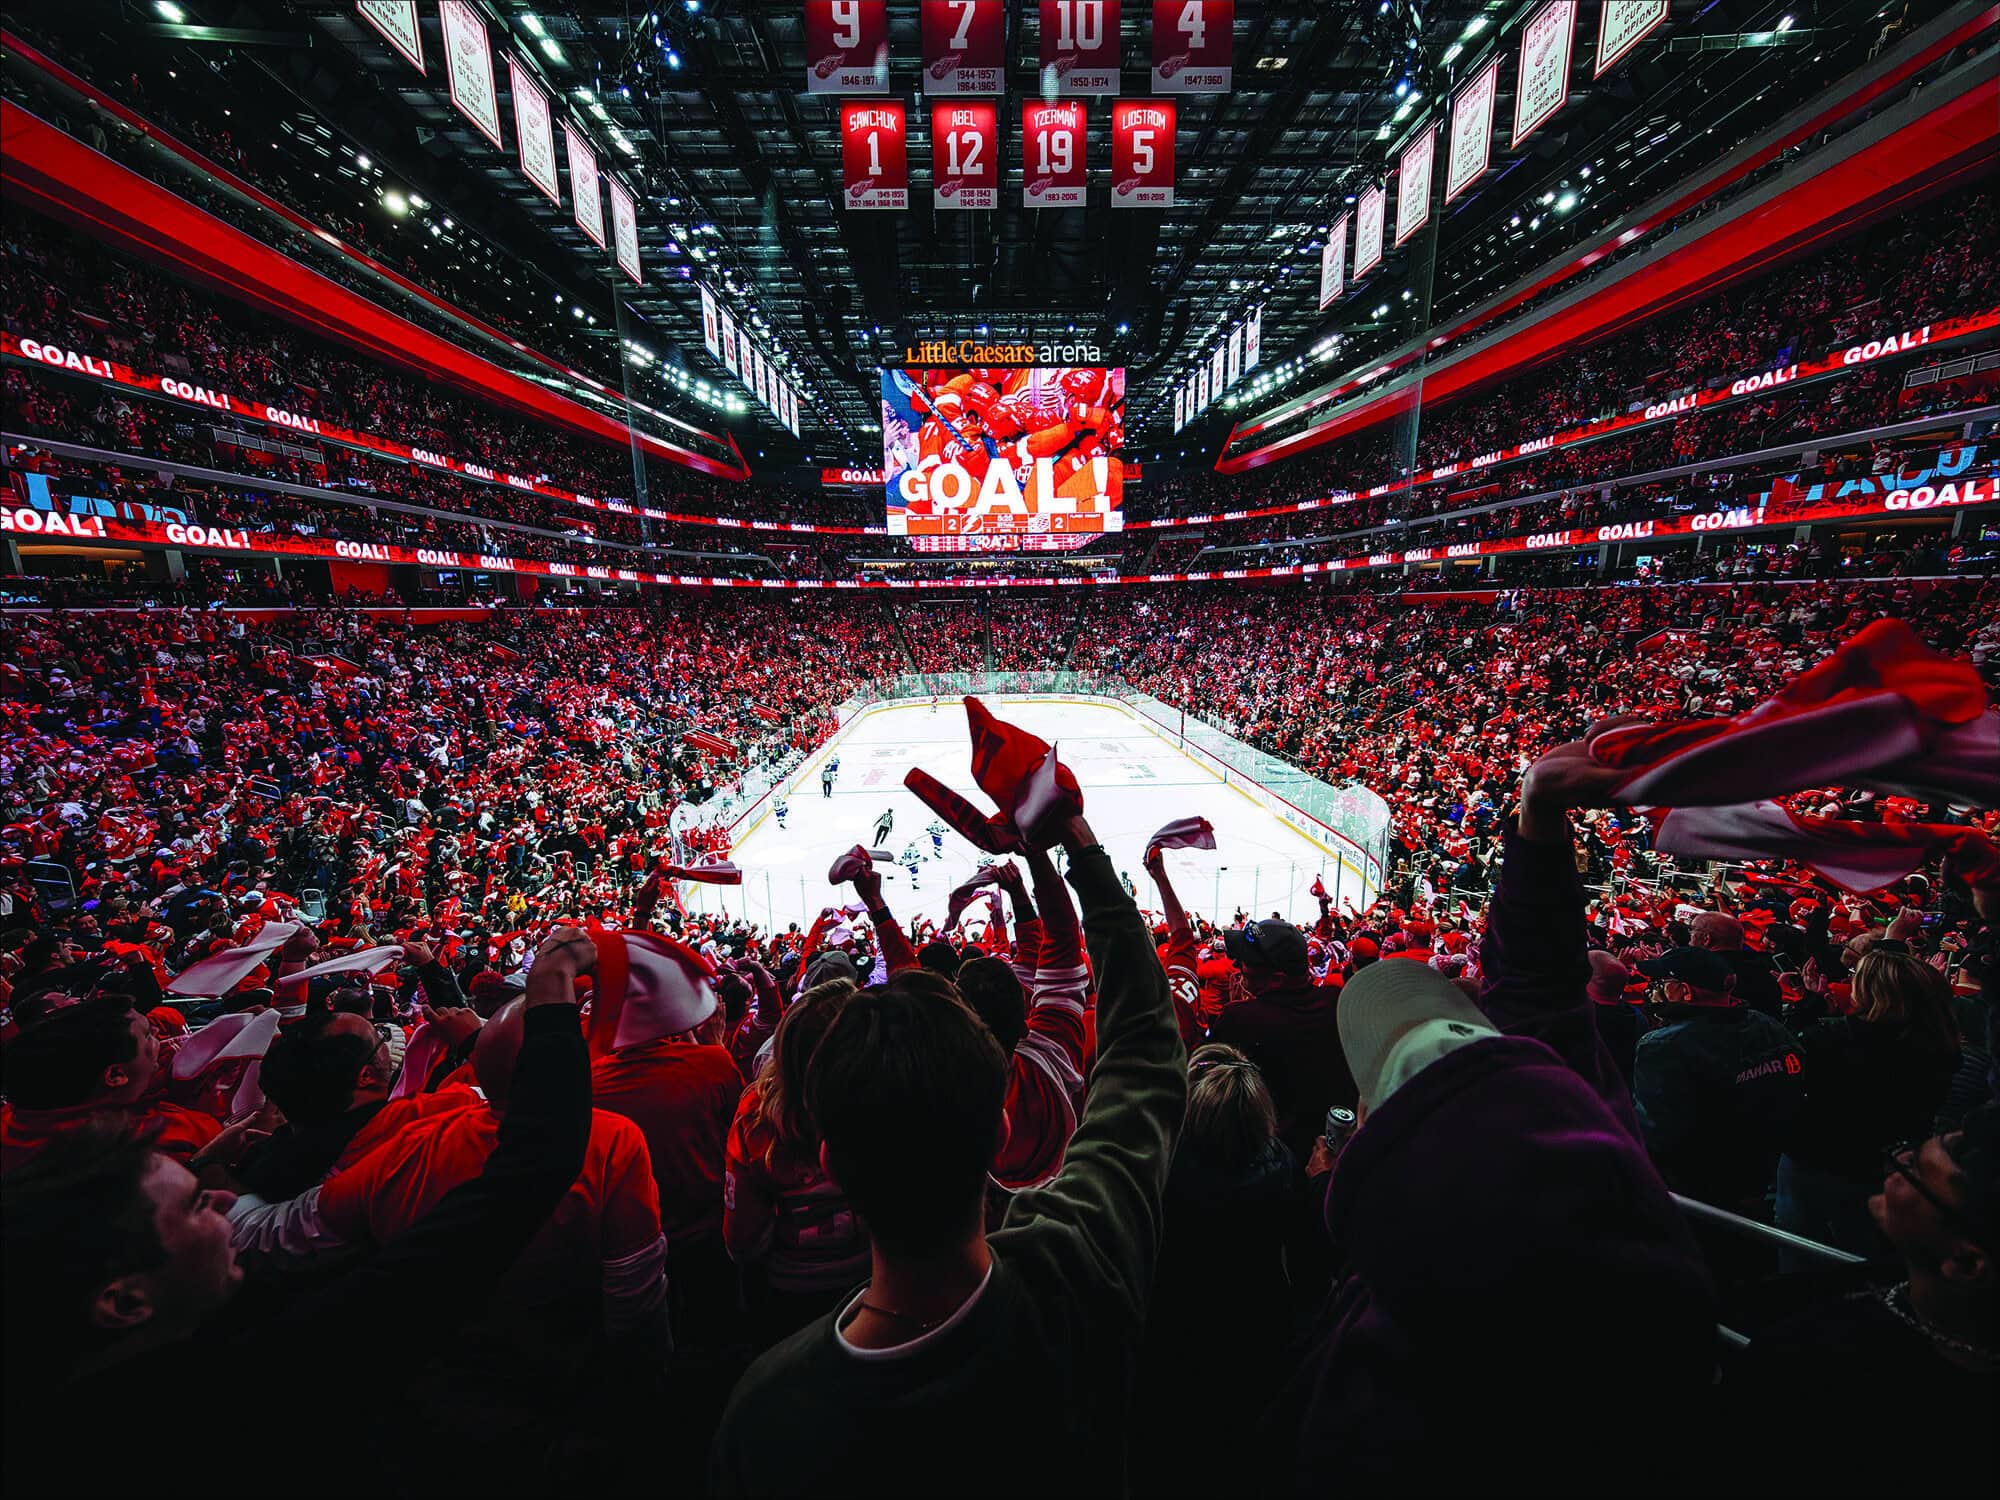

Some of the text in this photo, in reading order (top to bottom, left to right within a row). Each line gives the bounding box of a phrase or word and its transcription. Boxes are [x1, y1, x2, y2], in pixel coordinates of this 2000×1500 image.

[832, 0, 860, 48] 9
[949, 0, 976, 49] 7
[1057, 0, 1103, 50] 10
[1178, 0, 1206, 48] 4
[1605, 2, 1659, 54] CHAMPIONS
[952, 110, 977, 128] ABEL
[1033, 109, 1076, 129] YZERMAN
[1122, 109, 1166, 130] LIDSTROM
[1520, 88, 1559, 126] CHAMPIONS
[850, 110, 897, 132] SAWCHUK
[867, 131, 882, 175] 1
[946, 131, 984, 175] 12
[1036, 130, 1073, 174] 19
[1133, 130, 1154, 174] 5
[707, 313, 715, 343] 11
[905, 340, 1100, 363] Little Caesars arena
[1844, 326, 1930, 364] GOAL!
[20, 339, 113, 378] GOAL!
[1732, 365, 1797, 395] GOAL!
[161, 378, 230, 409] GOAL!
[1645, 394, 1697, 419] GOAL!
[266, 407, 320, 433] GOAL!
[412, 448, 447, 467] GOAL!
[1519, 436, 1553, 454] GOAL!
[1472, 451, 1501, 467] GOAL!
[465, 463, 493, 481] GOAL!
[900, 456, 1111, 514] GOAL!
[1885, 481, 2000, 510] GOAL!
[947, 518, 957, 531] 2
[1054, 517, 1063, 529] 2
[1598, 521, 1653, 540] GOAL!
[1691, 507, 1764, 530] GOAL!
[167, 524, 250, 548] GOAL!
[1526, 531, 1569, 548] GOAL!
[336, 541, 390, 560] GOAL!
[417, 549, 459, 565] GOAL!
[1448, 543, 1479, 556] GOAL!
[481, 556, 514, 570] GOAL!
[1735, 1060, 1784, 1085] MAHAR
